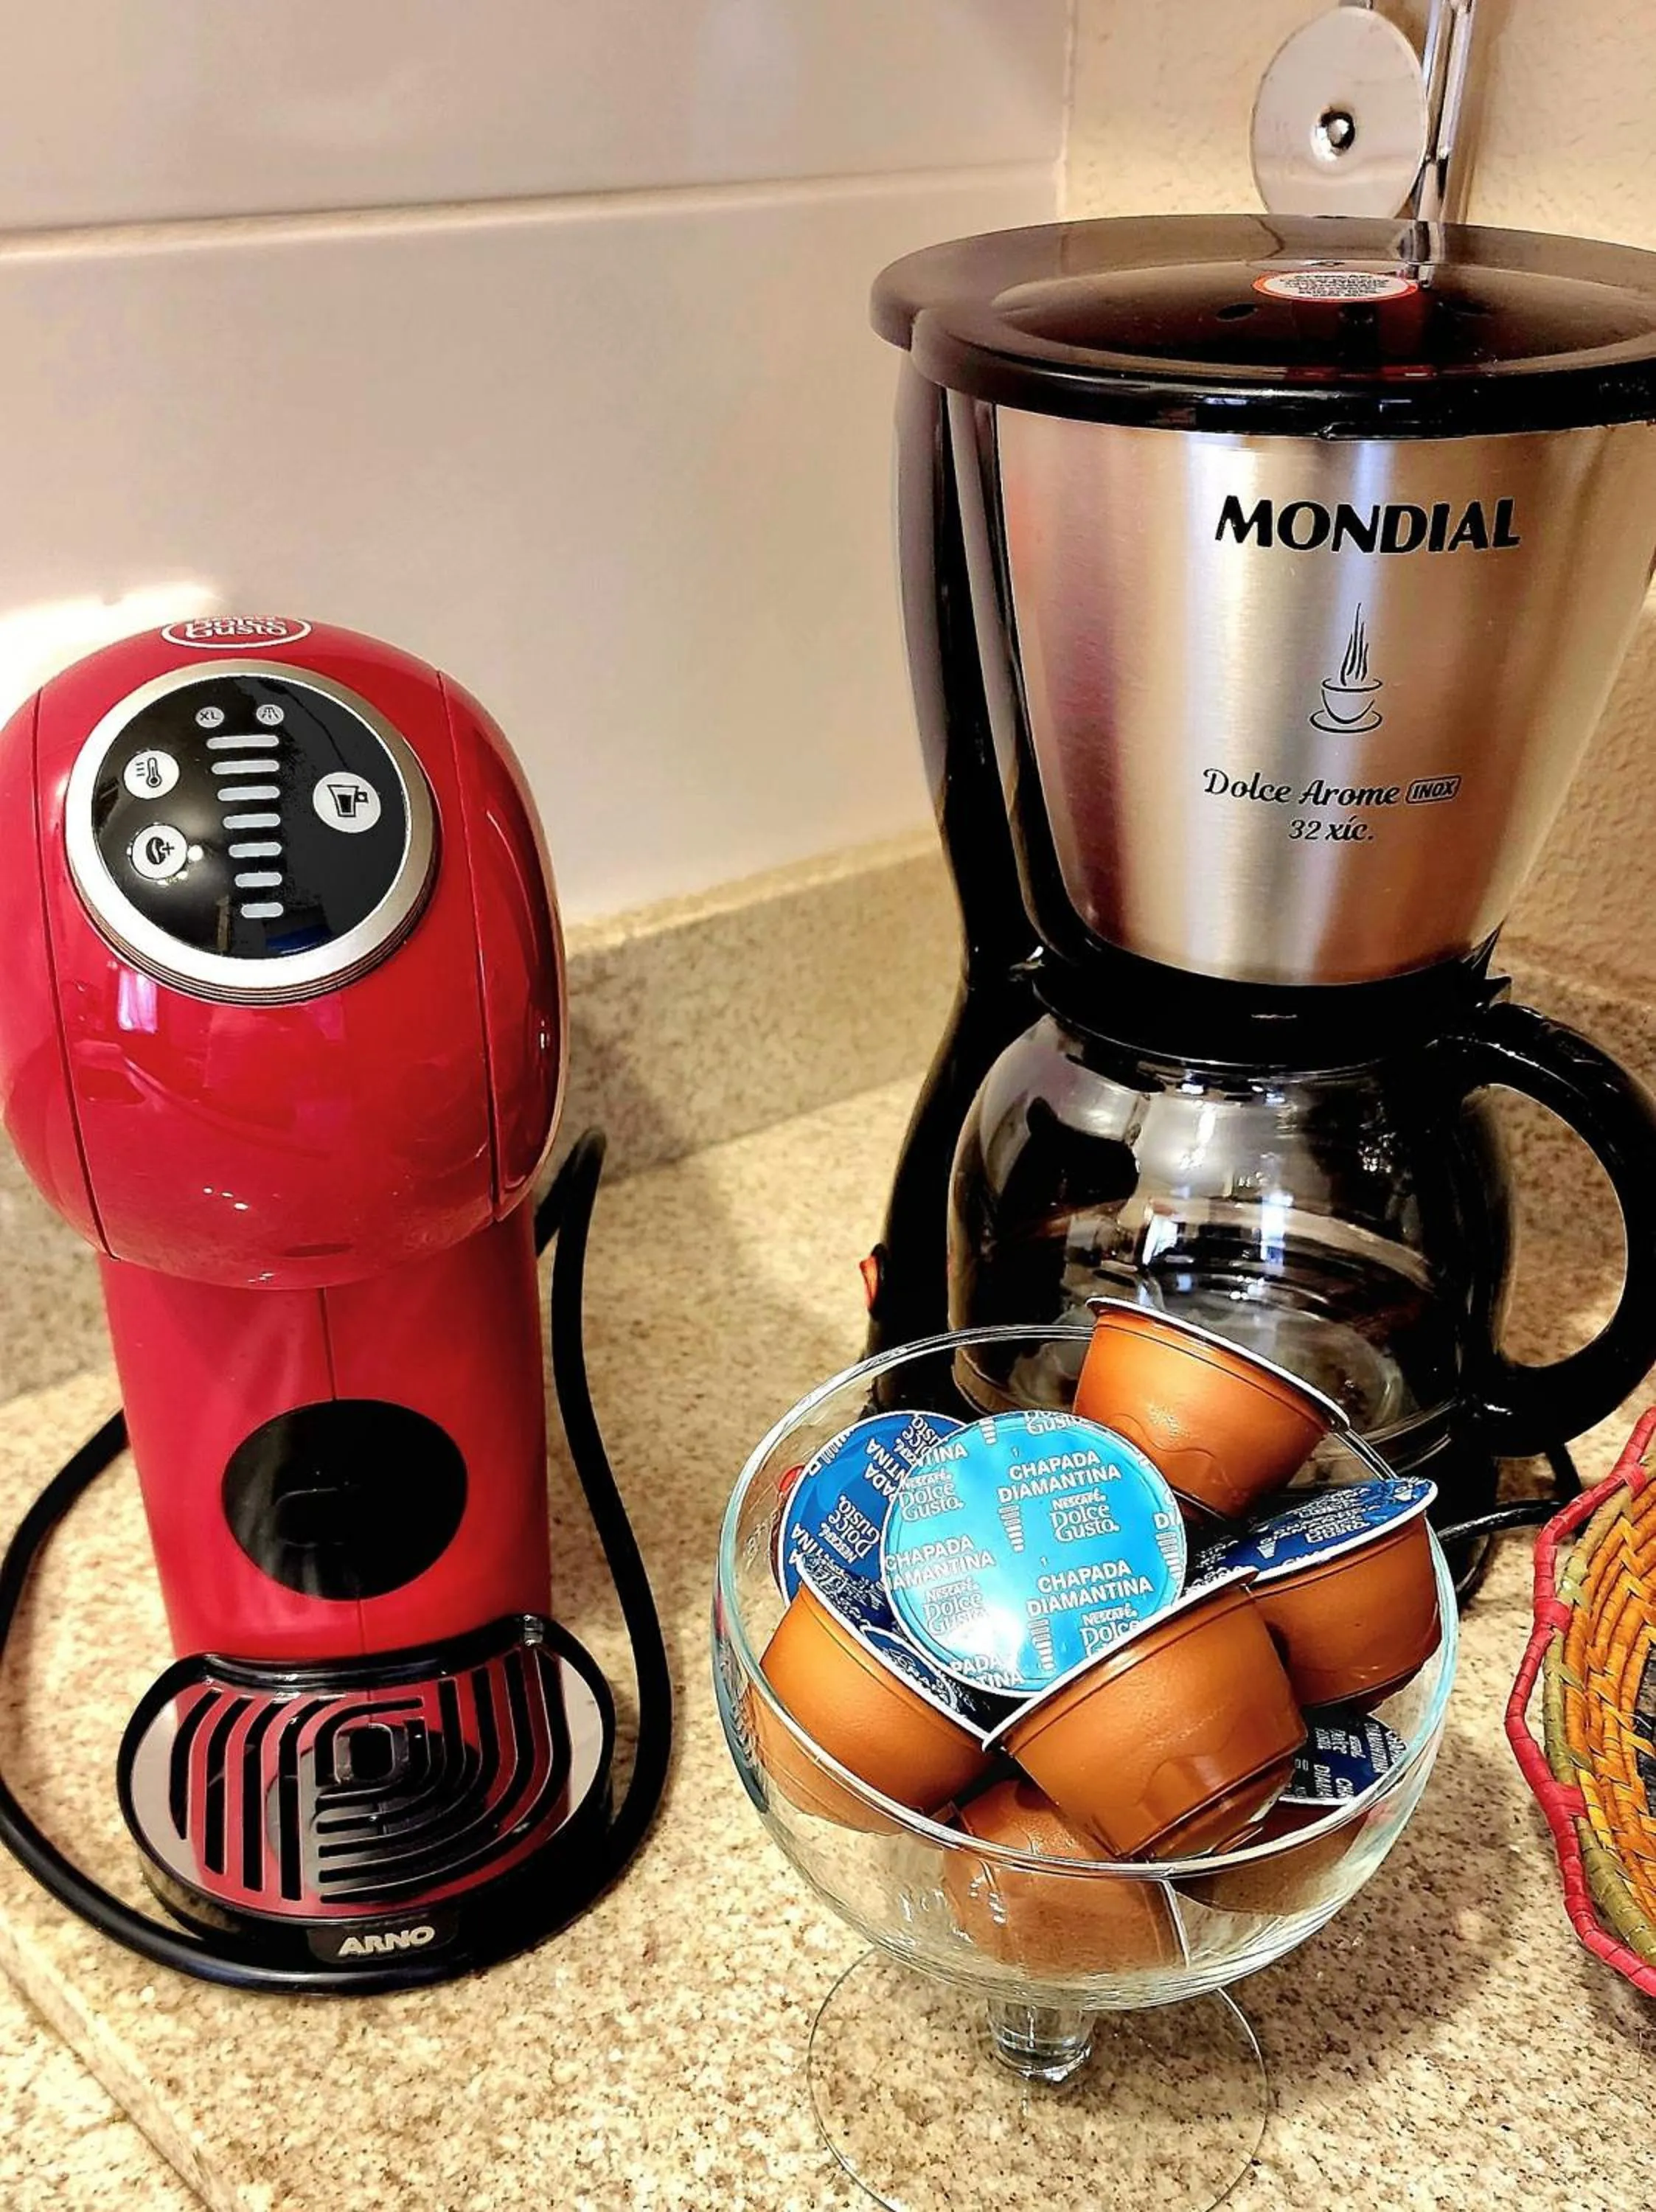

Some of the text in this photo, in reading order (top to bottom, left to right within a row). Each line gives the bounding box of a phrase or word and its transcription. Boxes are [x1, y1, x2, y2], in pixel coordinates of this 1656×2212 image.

[1215, 495, 1520, 553] MONDIAL
[200, 711, 221, 720] XL
[1203, 768, 1457, 805] Dolce Arome INOX
[1289, 815, 1374, 841] 32 xíc.
[1009, 1450, 1101, 1481] CHAPADA
[997, 1464, 1121, 1503] DIAMANTINA
[1049, 1503, 1111, 1528] Dolce
[828, 1509, 873, 1559] Dolce
[886, 1535, 974, 1571] CHAPADA
[1037, 1559, 1133, 1593] CHAPADA
[1026, 1575, 1155, 1616] DIAMANTINA
[338, 1926, 436, 1957] ARNO
